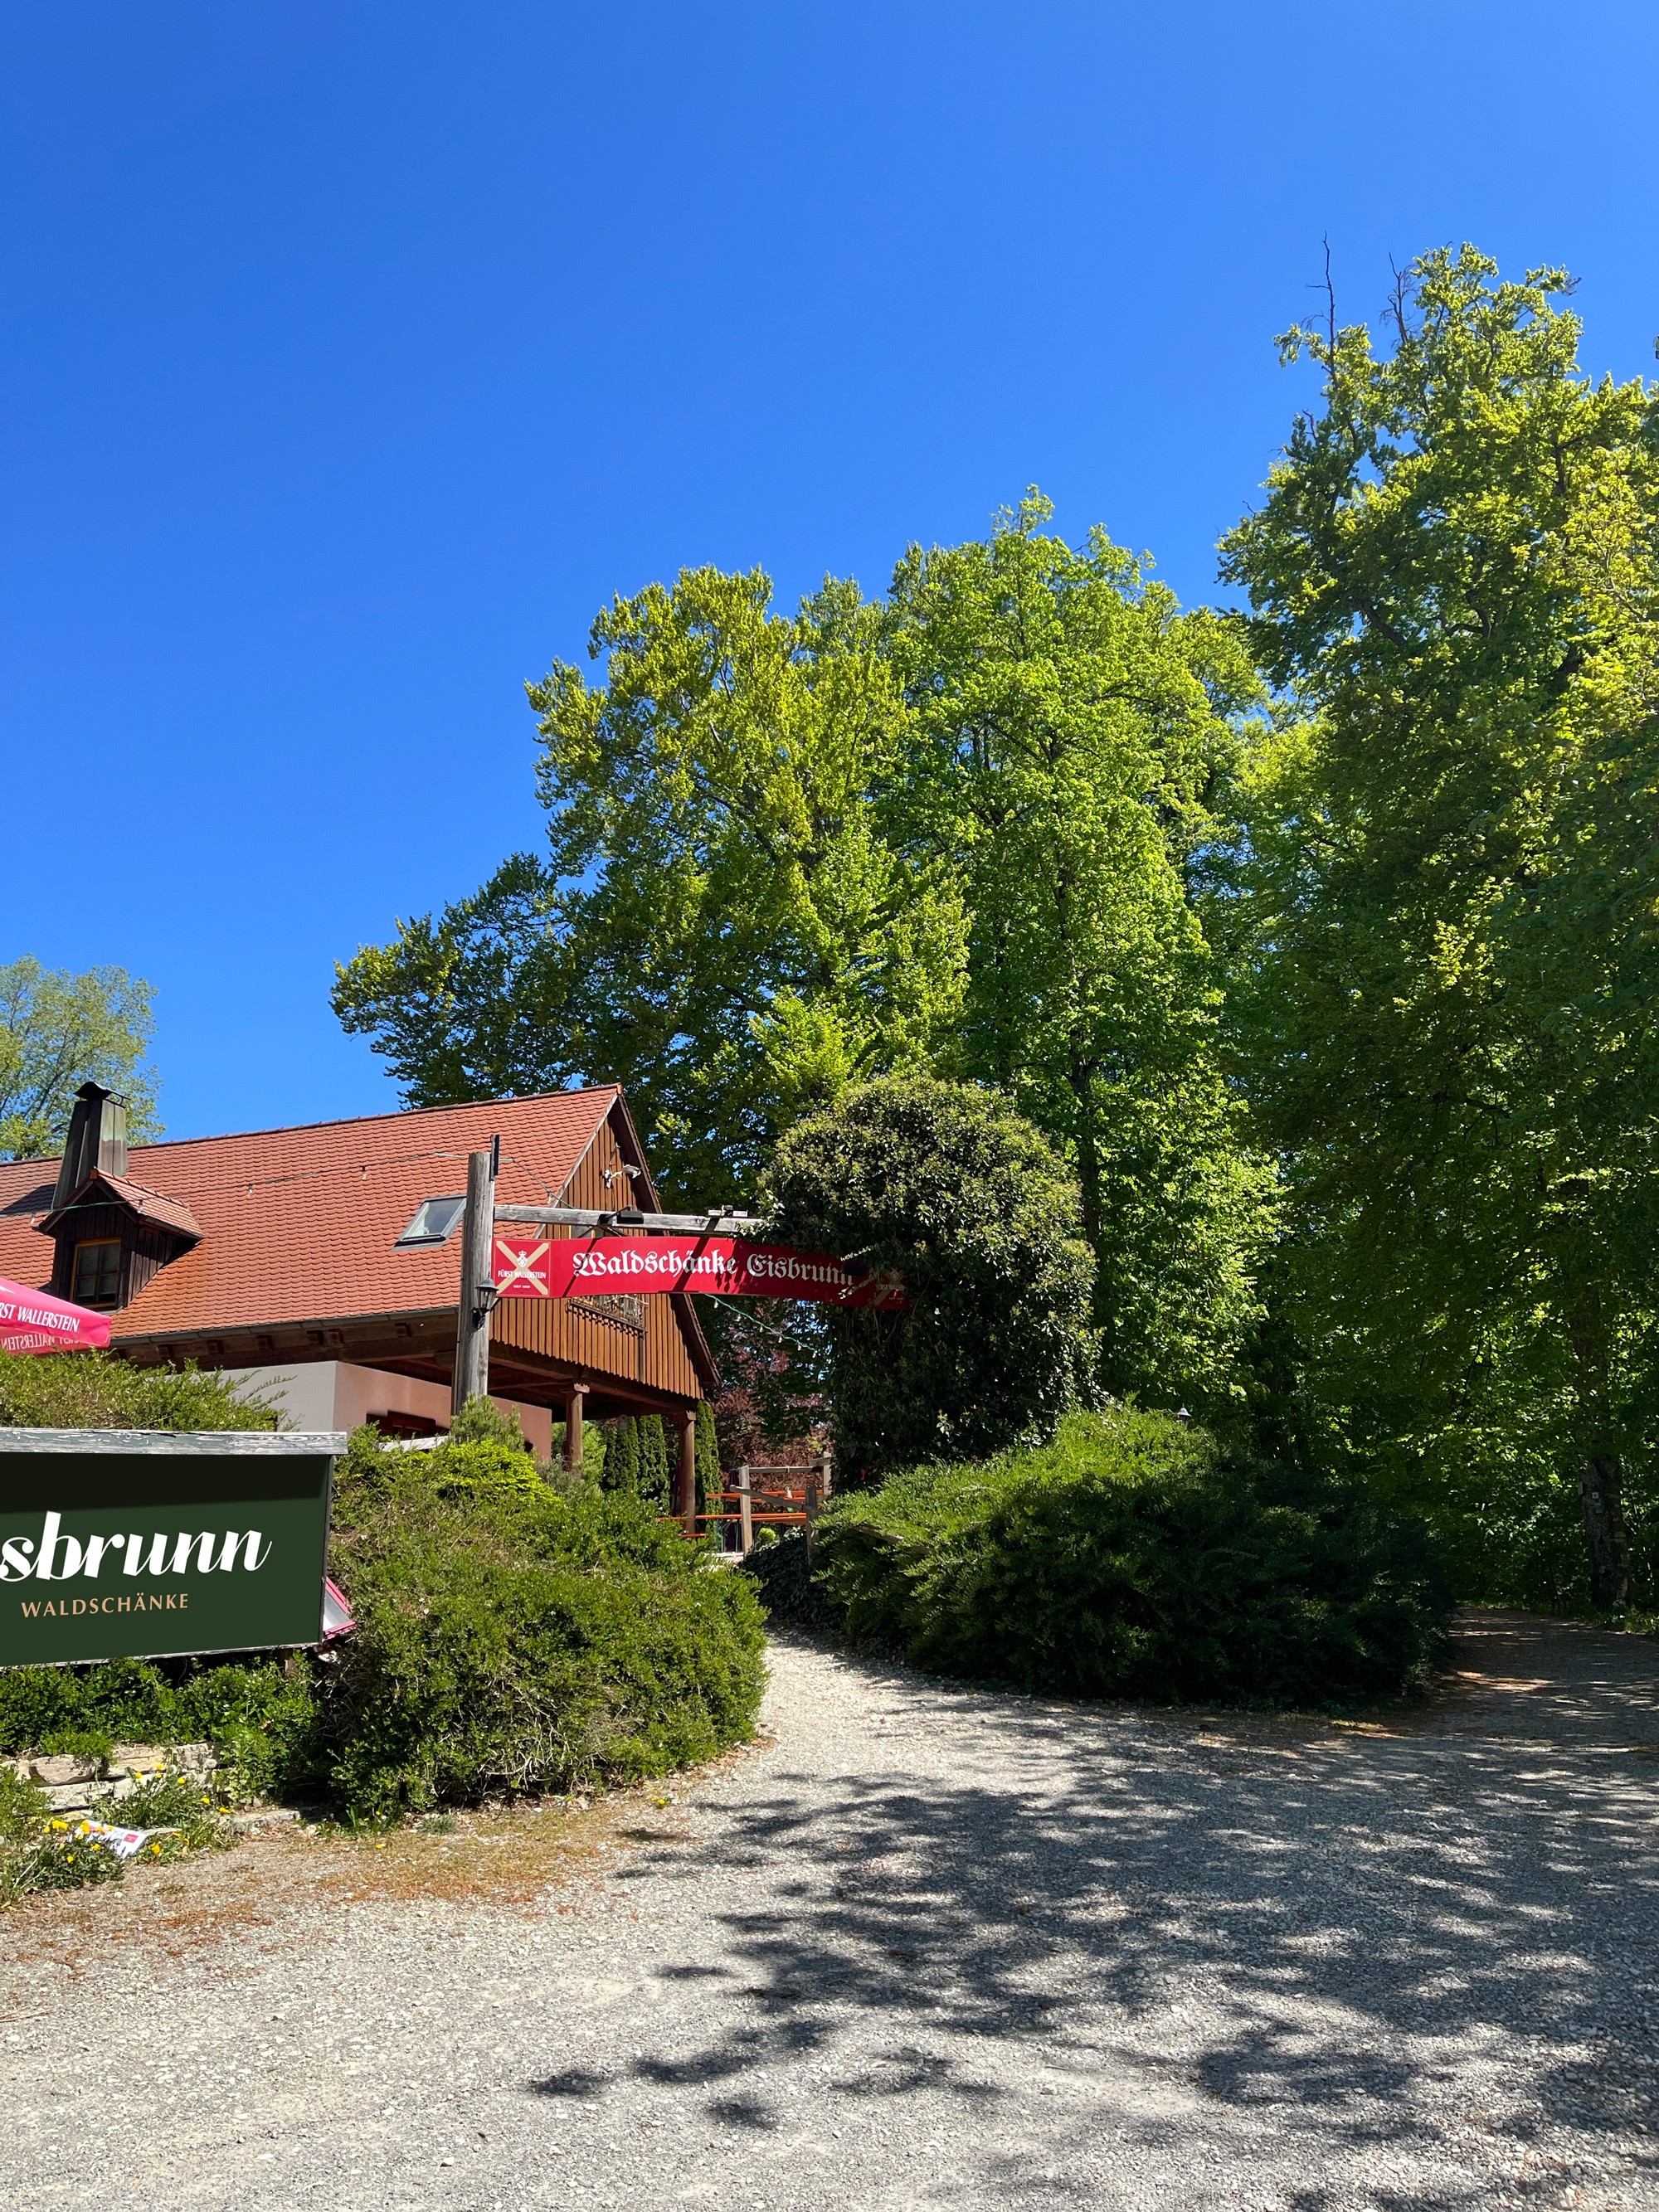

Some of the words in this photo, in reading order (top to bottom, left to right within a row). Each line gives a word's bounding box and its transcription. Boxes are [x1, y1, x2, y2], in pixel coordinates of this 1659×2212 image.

[498, 1269, 513, 1278] FÜRST
[513, 1271, 547, 1279] WALLERSTEIN
[572, 1249, 737, 1277] Waldschänke
[747, 1253, 854, 1286] Eisbrunn
[0, 1302, 17, 1319] RST
[17, 1306, 80, 1333] WALLERSTEIN
[0, 1510, 272, 1582] sbrunn
[21, 1592, 188, 1617] WALDSCHÄNKE
